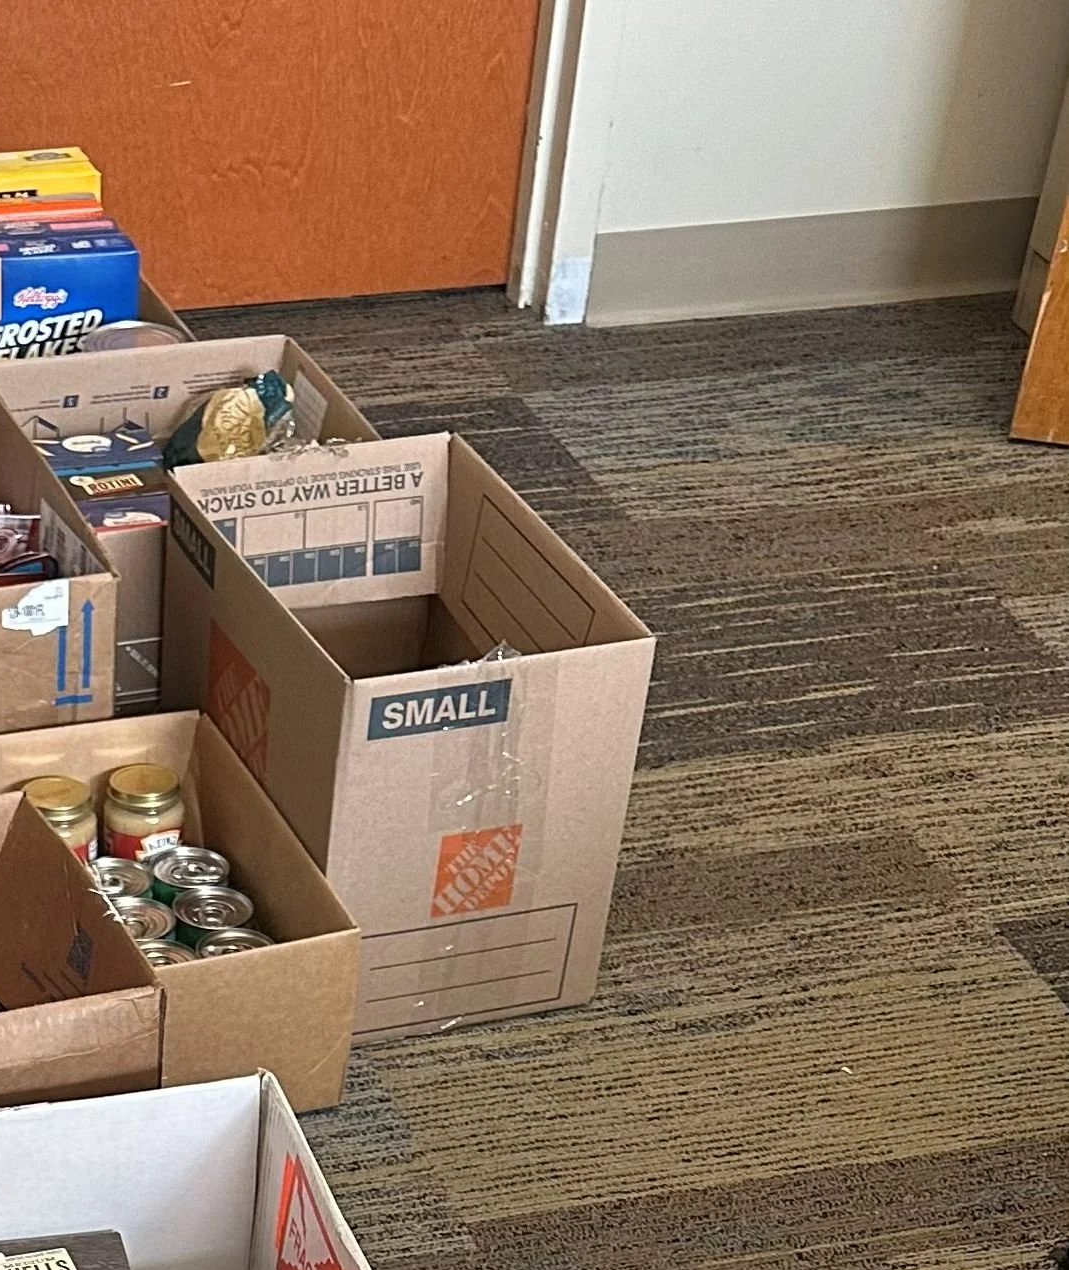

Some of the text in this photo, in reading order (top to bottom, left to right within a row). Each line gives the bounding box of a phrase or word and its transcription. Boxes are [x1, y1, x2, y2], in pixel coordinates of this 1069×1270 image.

[87, 474, 135, 494] ROTINI
[336, 475, 405, 497] BETTER
[413, 471, 424, 488] A
[262, 490, 286, 506] TO
[293, 485, 330, 503] WAY
[381, 690, 497, 731] SMALL
